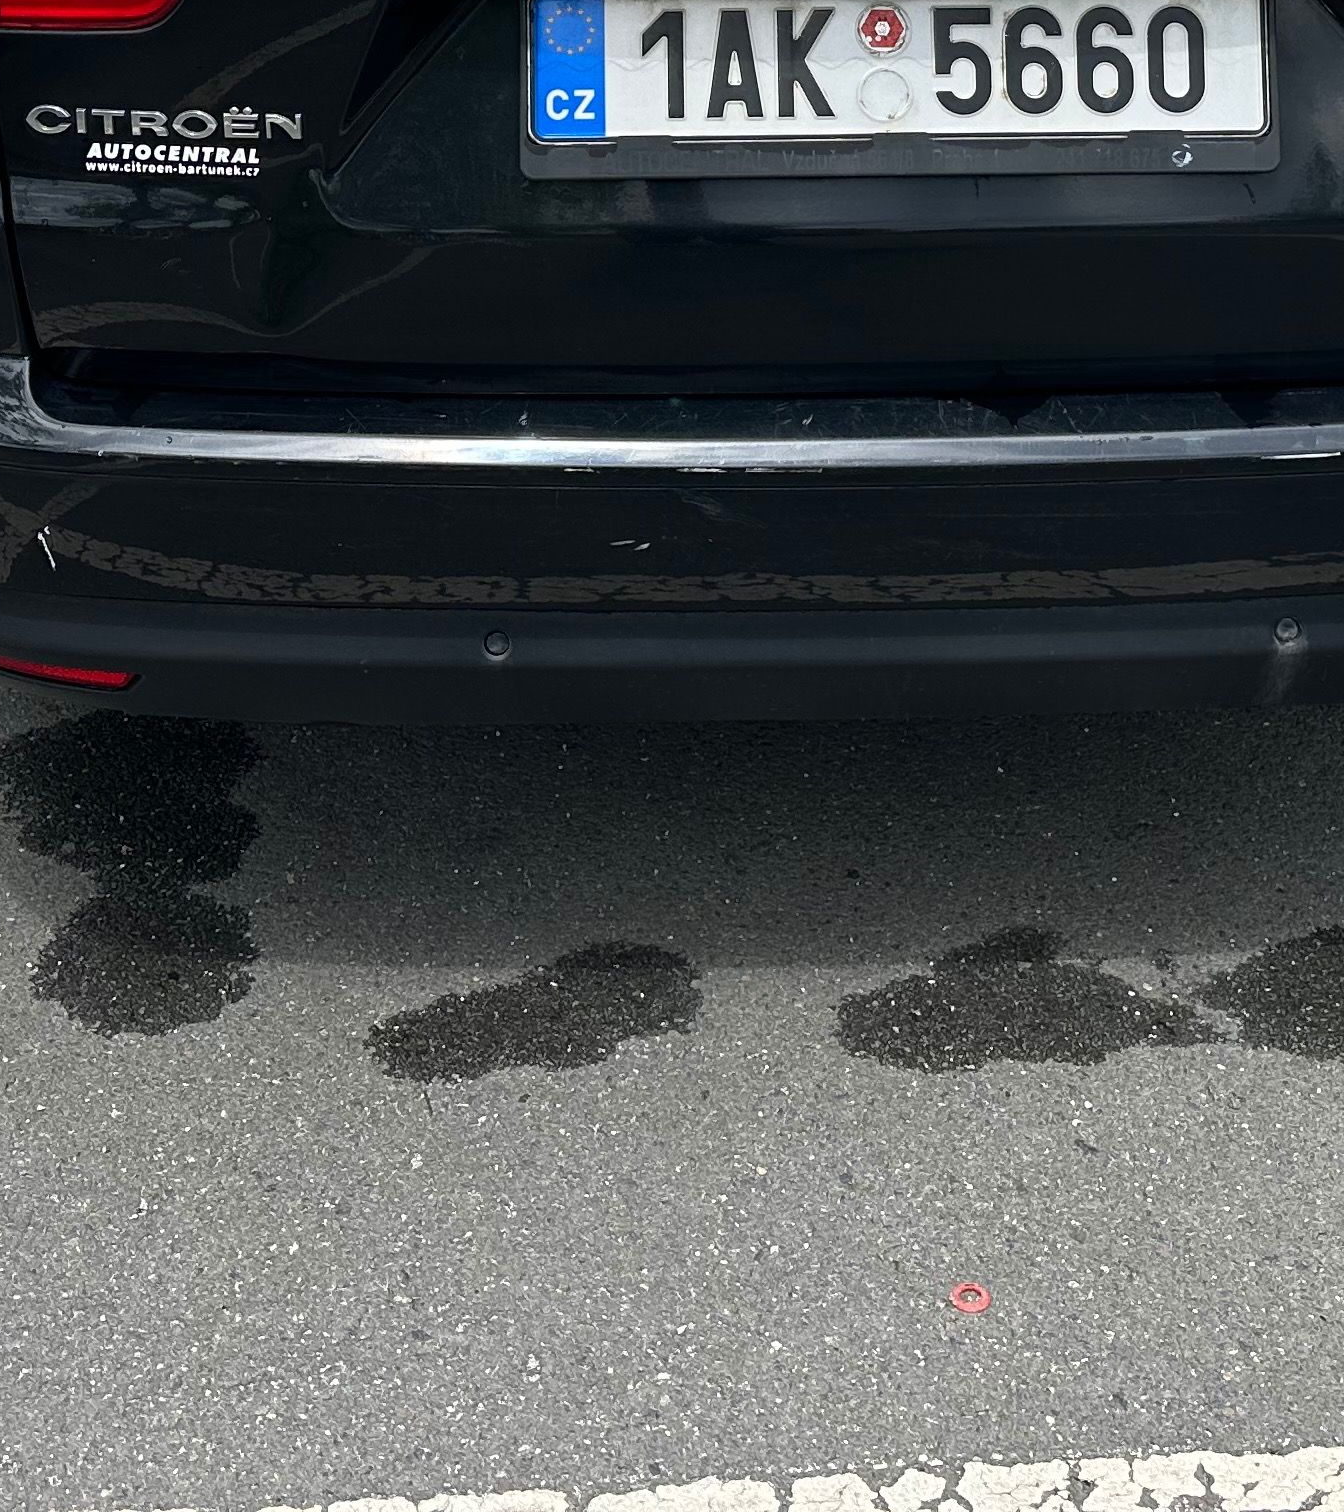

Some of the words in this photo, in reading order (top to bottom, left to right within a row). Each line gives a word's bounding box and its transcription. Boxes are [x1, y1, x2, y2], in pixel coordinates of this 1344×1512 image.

[640, 6, 838, 120] 1AK
[931, 5, 1208, 116] 5660
[545, 89, 596, 121] CZ
[25, 104, 304, 141] CITROËN
[85, 160, 260, 177] www.citroen-bartunek.cz
[86, 142, 260, 165] AUTOCENTRAL
